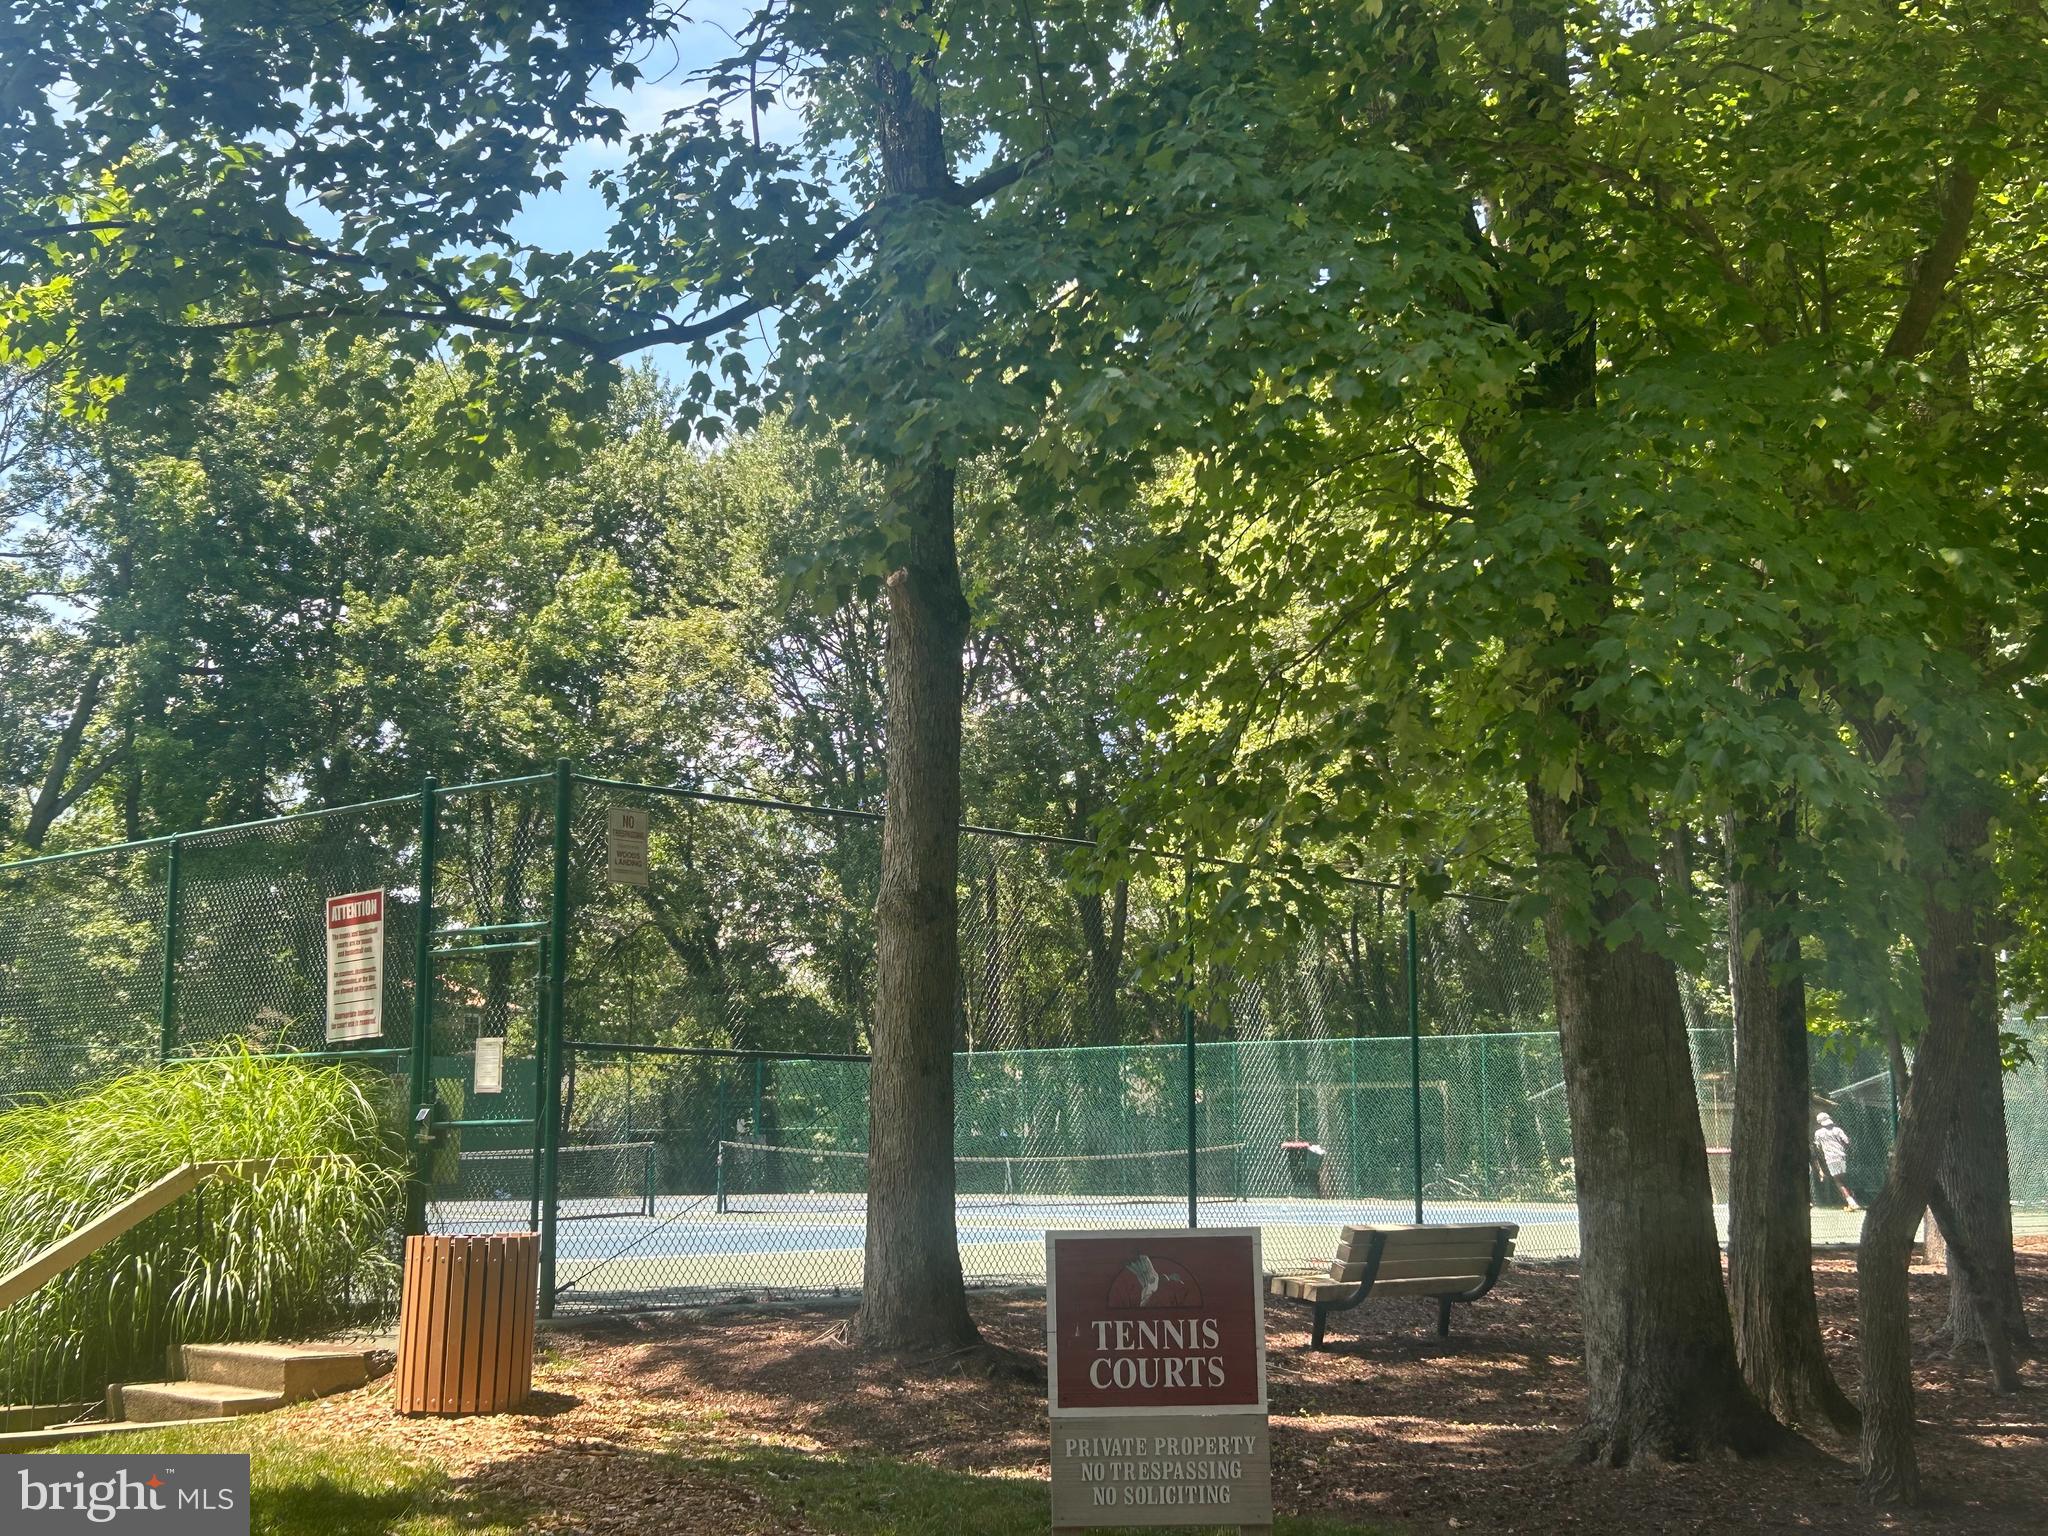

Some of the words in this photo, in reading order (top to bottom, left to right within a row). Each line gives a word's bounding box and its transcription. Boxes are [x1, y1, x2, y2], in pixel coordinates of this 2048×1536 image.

[622, 815, 635, 829] NO
[331, 898, 377, 922] ATTENTION
[1091, 1318, 1220, 1351] TENNIS
[1089, 1356, 1225, 1389] COURTS
[1065, 1438, 1147, 1458] PRIVATE
[1154, 1436, 1257, 1456] PROPERTY
[1081, 1462, 1105, 1482] NO
[1110, 1460, 1242, 1481] TRESPASSING
[1093, 1486, 1117, 1506] NO
[1124, 1485, 1231, 1506] SOLICITING
